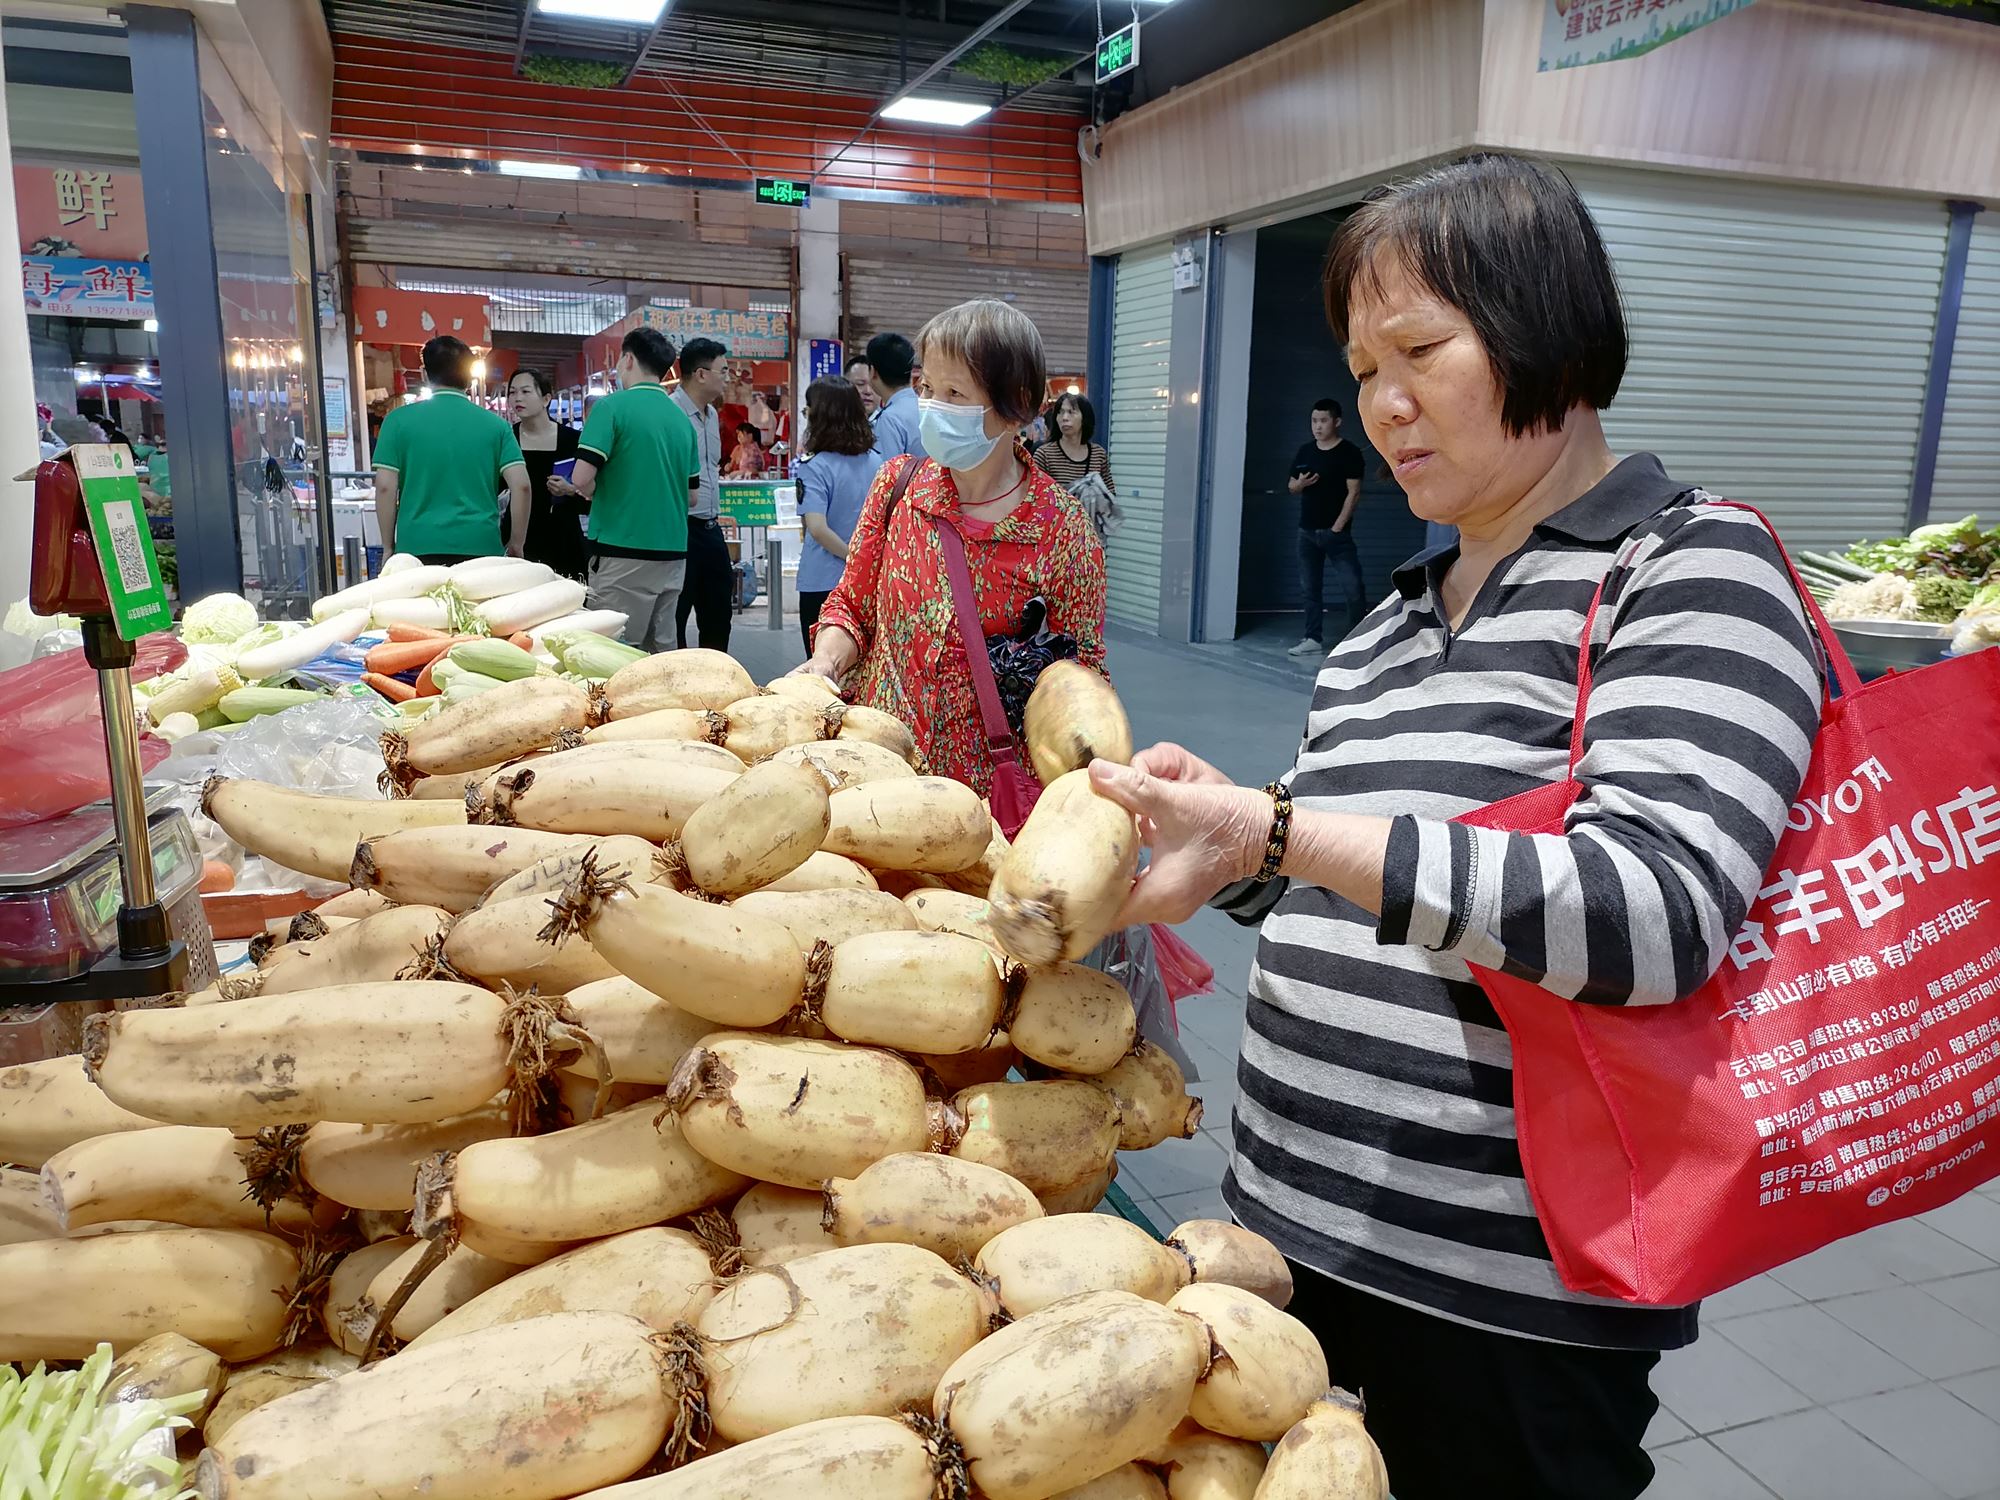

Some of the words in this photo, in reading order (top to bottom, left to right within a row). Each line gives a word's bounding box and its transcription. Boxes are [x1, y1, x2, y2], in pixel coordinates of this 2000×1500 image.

[54, 168, 119, 231] 鲜
[1755, 1097, 1816, 1138] 新兴分公司
[1760, 1154, 1837, 1189] 罗定分公司
